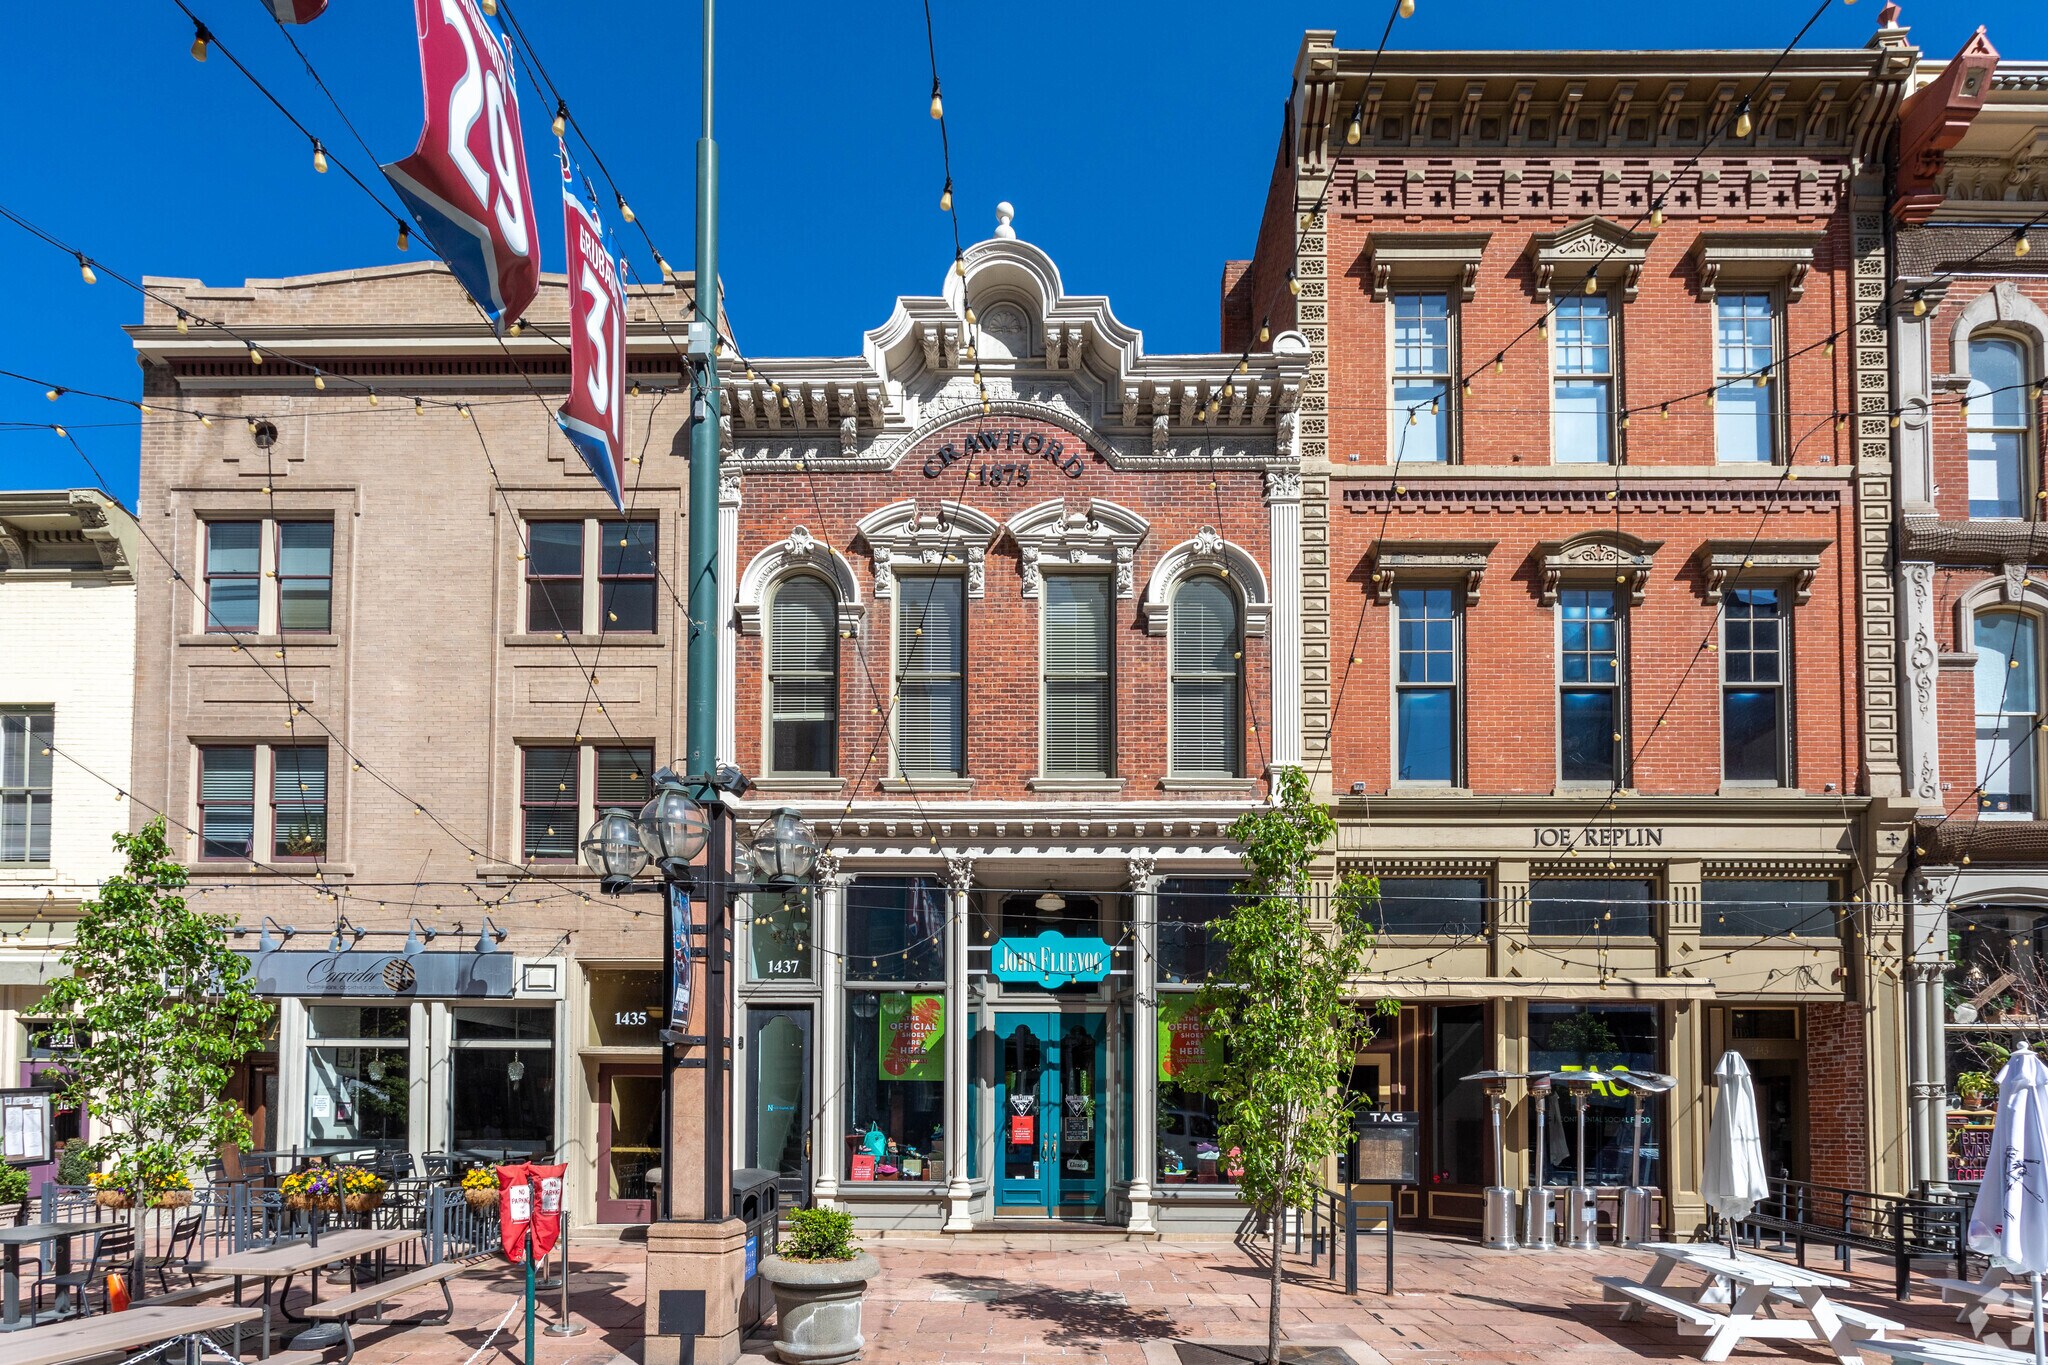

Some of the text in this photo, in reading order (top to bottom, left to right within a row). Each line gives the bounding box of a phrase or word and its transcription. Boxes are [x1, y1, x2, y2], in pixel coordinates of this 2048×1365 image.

[440, 0, 529, 258] 29
[579, 259, 620, 444] 31
[922, 429, 1085, 479] CRAWFORD
[1533, 828, 1664, 848] JOE REPLIN
[999, 946, 1103, 972] JOHN FLUEVOG
[306, 956, 398, 984] Corridor
[767, 959, 800, 974] 1437
[614, 1011, 648, 1026] 1435
[889, 1023, 938, 1031] OFFICIAL
[900, 1046, 927, 1055] HERE
[1179, 1047, 1206, 1055] HERE
[1369, 1112, 1403, 1123] TAG
[1630, 1116, 1651, 1124] FOD
[1962, 1131, 1991, 1145] BEER
[1963, 1145, 1991, 1157] WINE
[542, 1188, 560, 1196] PARKING
